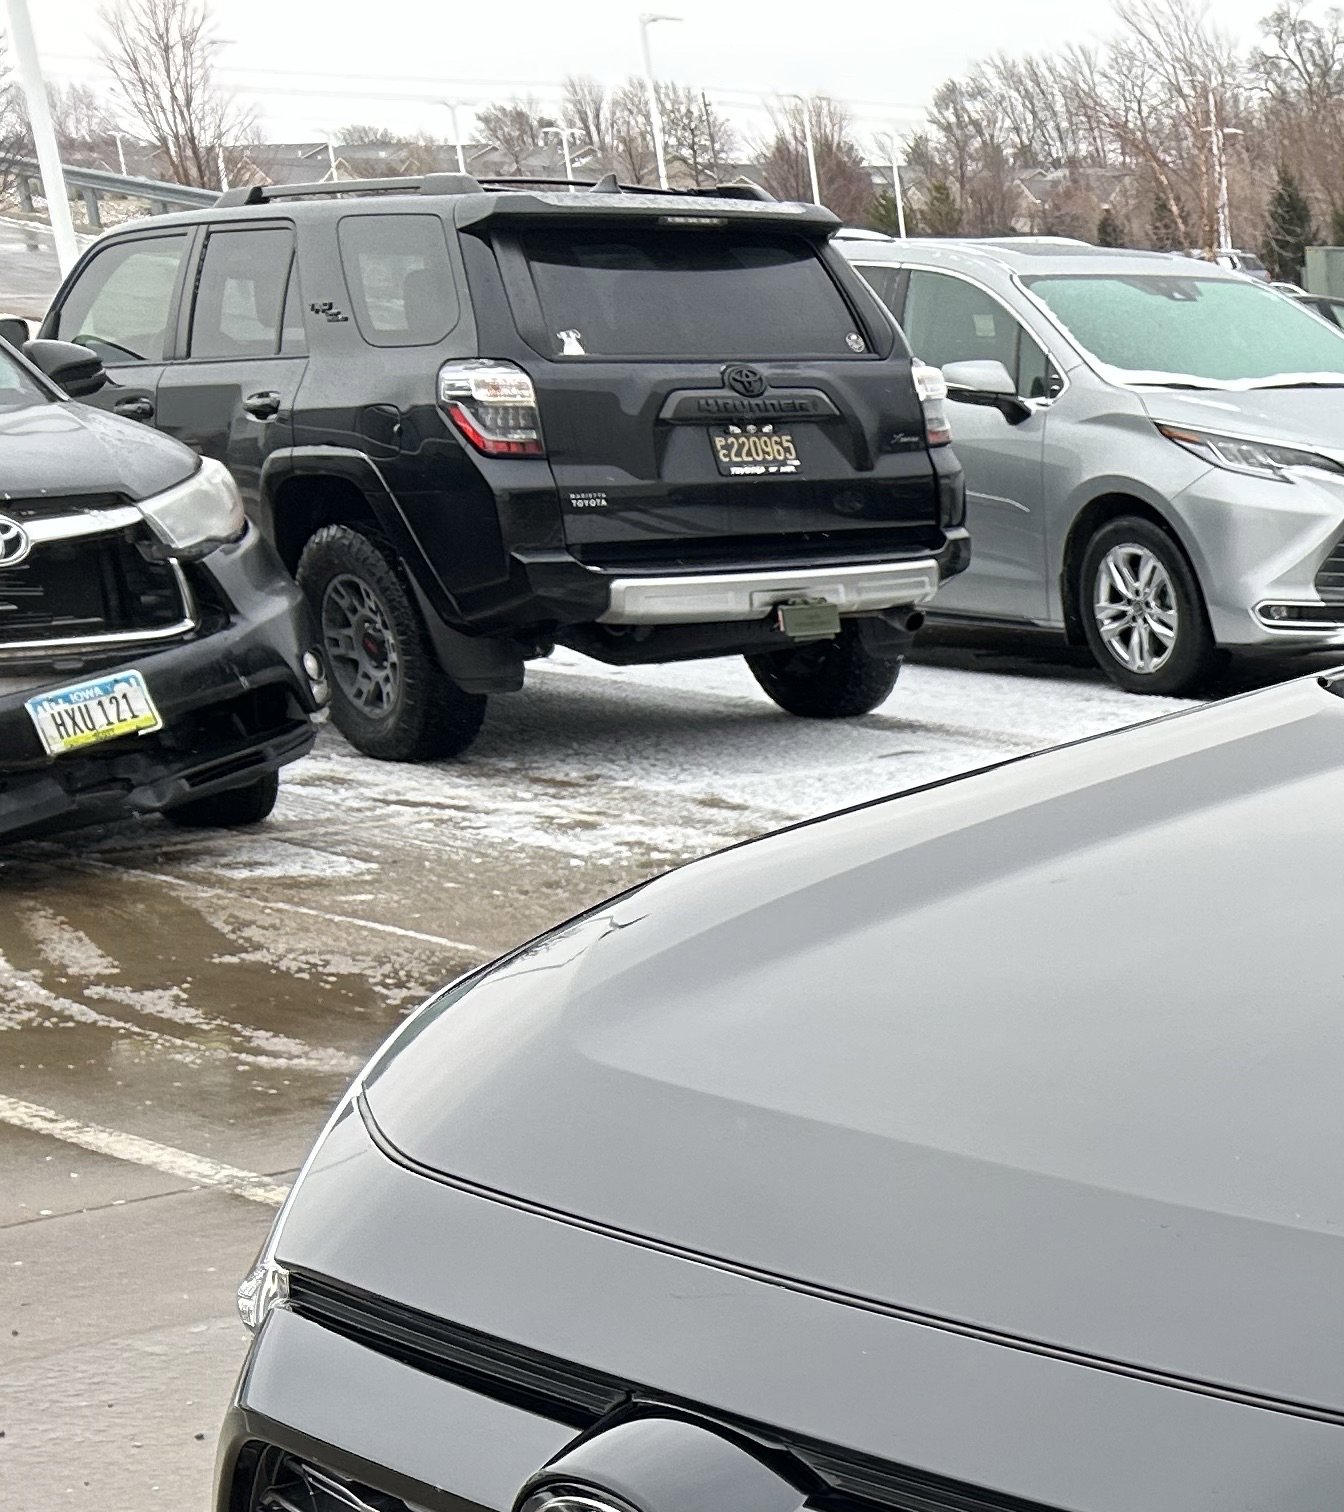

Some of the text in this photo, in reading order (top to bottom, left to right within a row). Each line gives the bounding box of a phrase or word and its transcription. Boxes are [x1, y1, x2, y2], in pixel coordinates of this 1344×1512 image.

[727, 434, 797, 461] 220965
[570, 498, 607, 508] TOYOTA
[69, 686, 103, 702] IOWA
[50, 692, 139, 740] HXU 121
